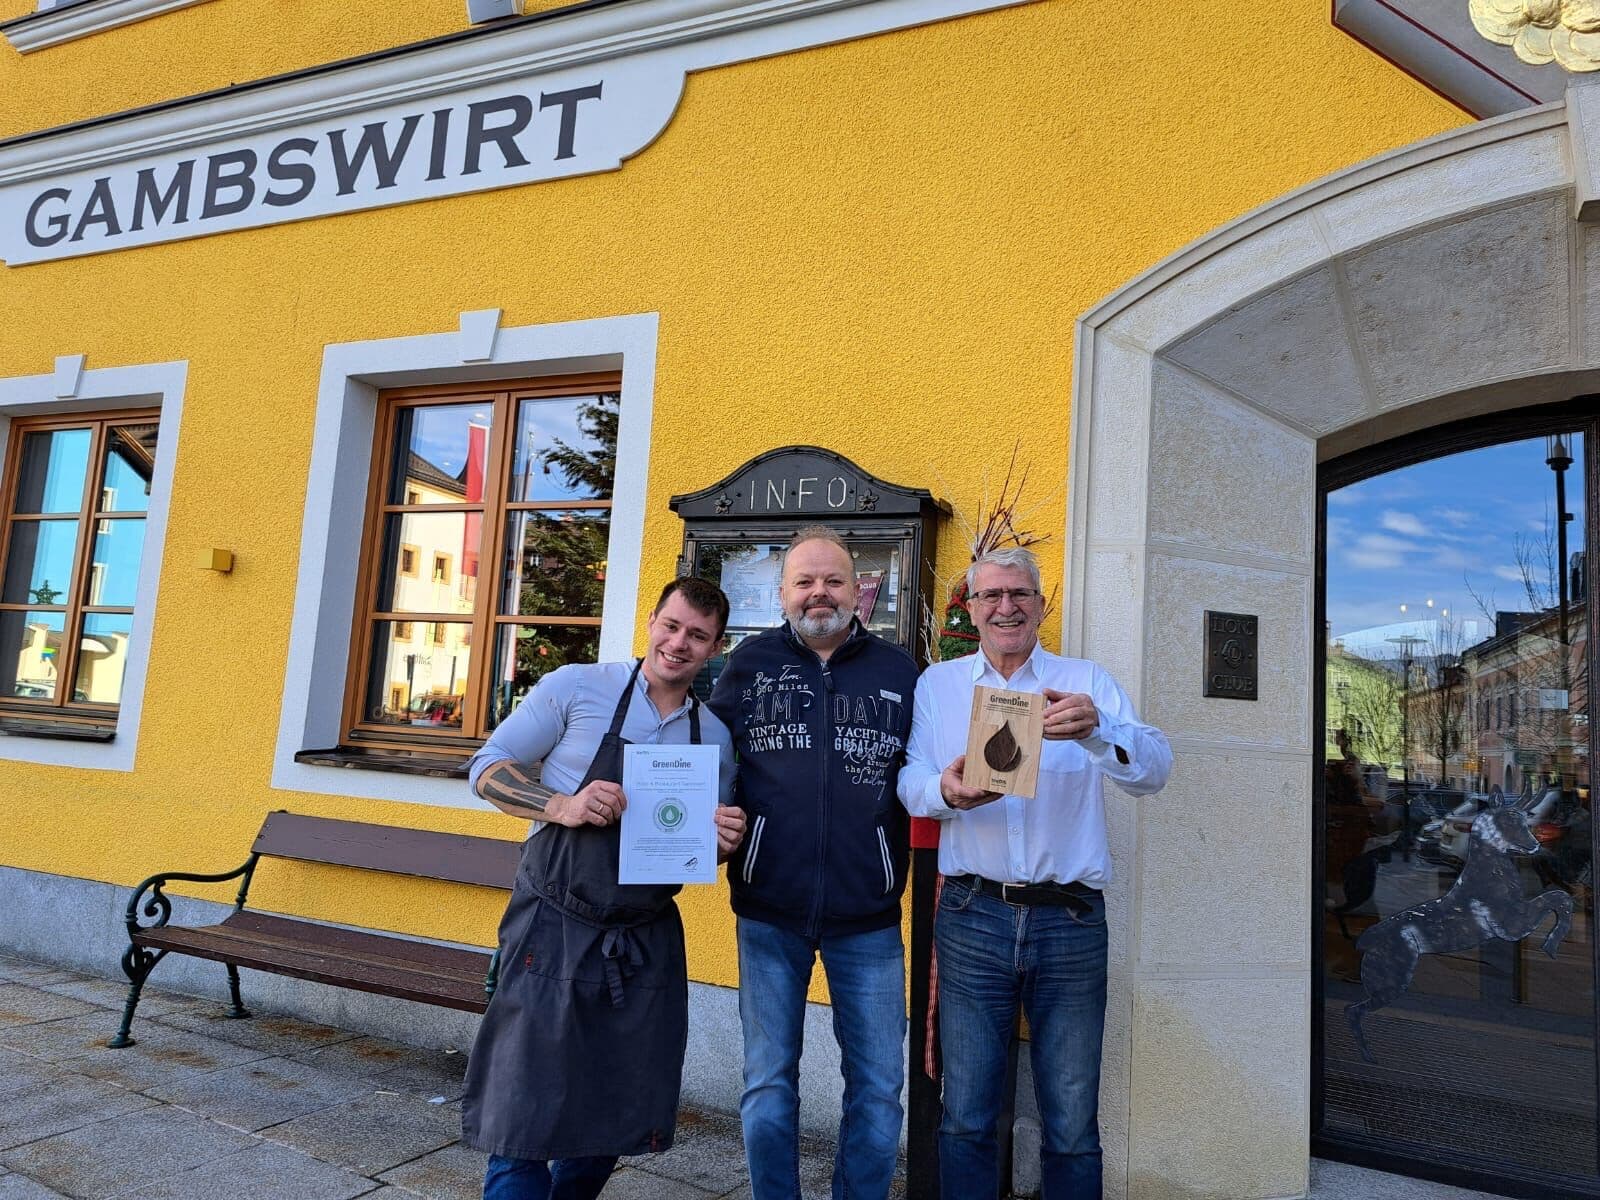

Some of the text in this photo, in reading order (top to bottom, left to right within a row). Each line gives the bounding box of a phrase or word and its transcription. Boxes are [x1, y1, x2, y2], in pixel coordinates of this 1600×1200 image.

[25, 81, 603, 247] GAMBSWIRT
[750, 477, 847, 509] INFO
[990, 695, 1030, 708] GreenDine
[749, 723, 808, 739] VINTAGE
[834, 726, 879, 741] YACHT
[787, 734, 812, 750] THE
[652, 757, 692, 769] GreenDine
